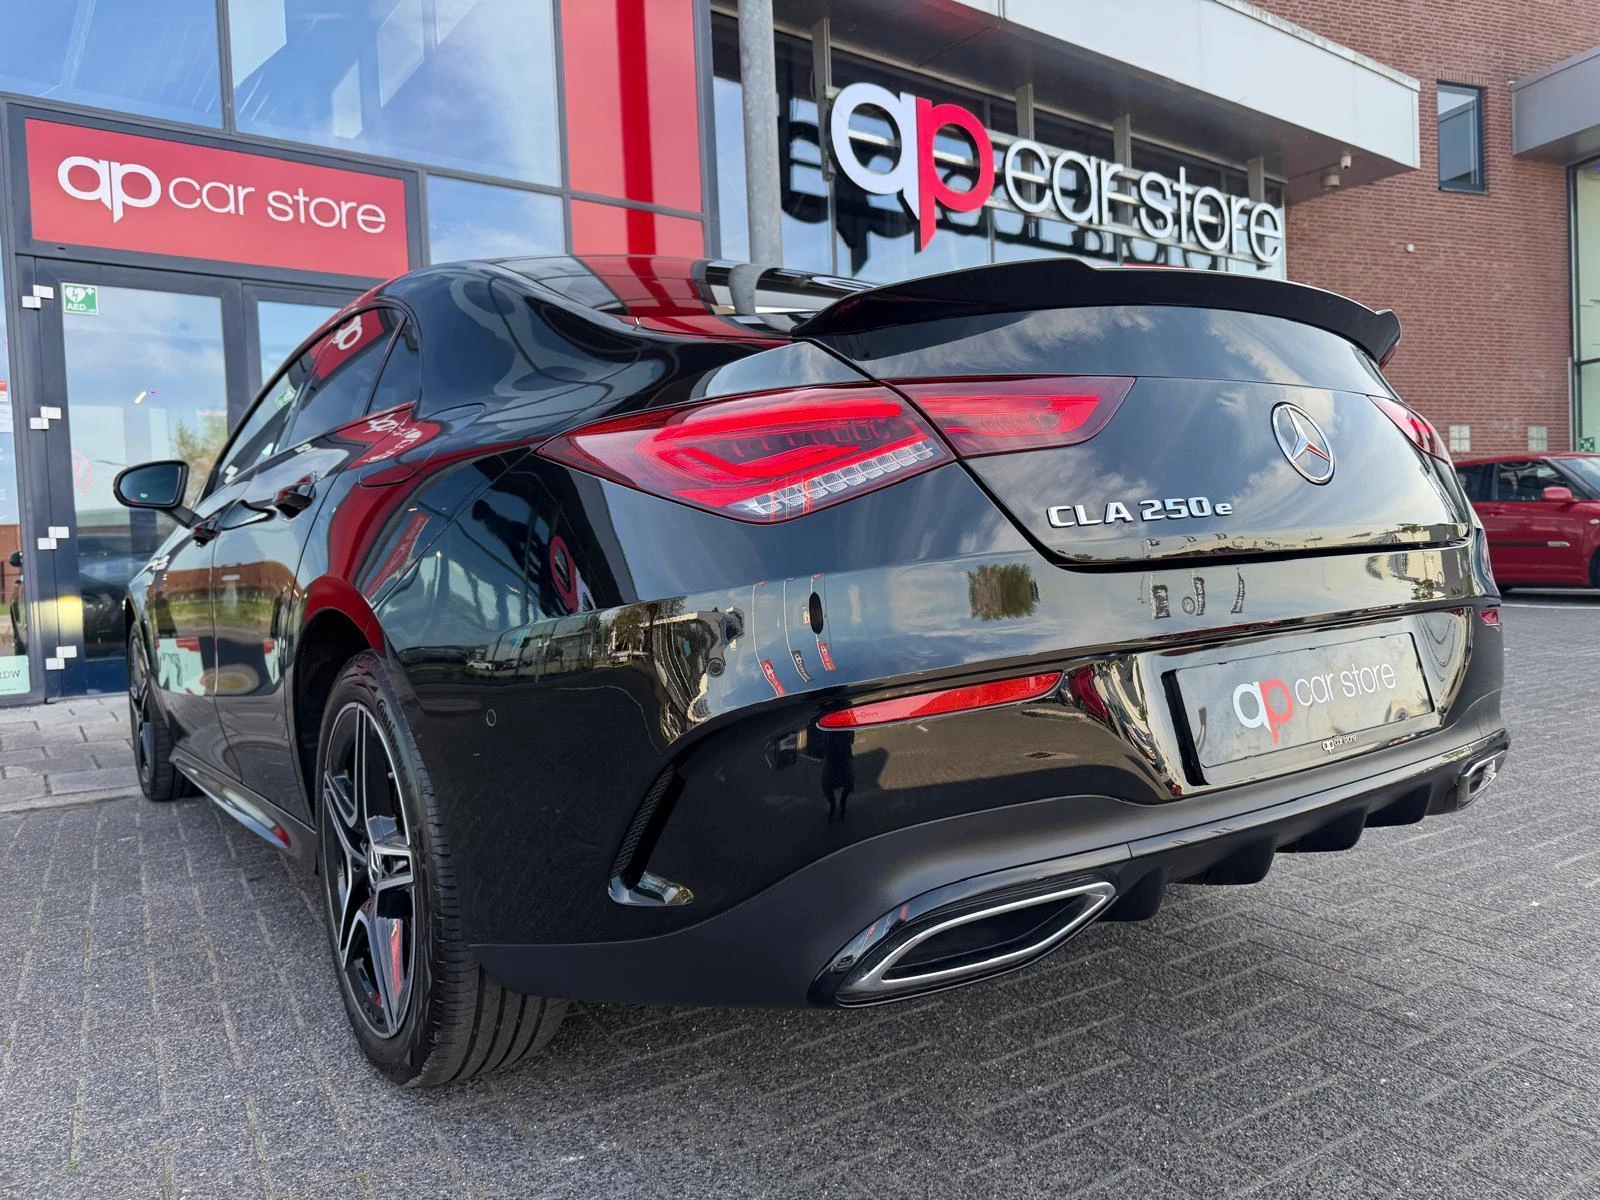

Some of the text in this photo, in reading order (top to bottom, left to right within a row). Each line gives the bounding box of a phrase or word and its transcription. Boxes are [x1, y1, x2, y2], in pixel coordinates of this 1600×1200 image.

[57, 156, 387, 234] ap car store
[831, 82, 1283, 263] ap car store
[66, 302, 87, 312] AED
[1047, 501, 1134, 528] CLA
[1232, 663, 1397, 748] ap car store
